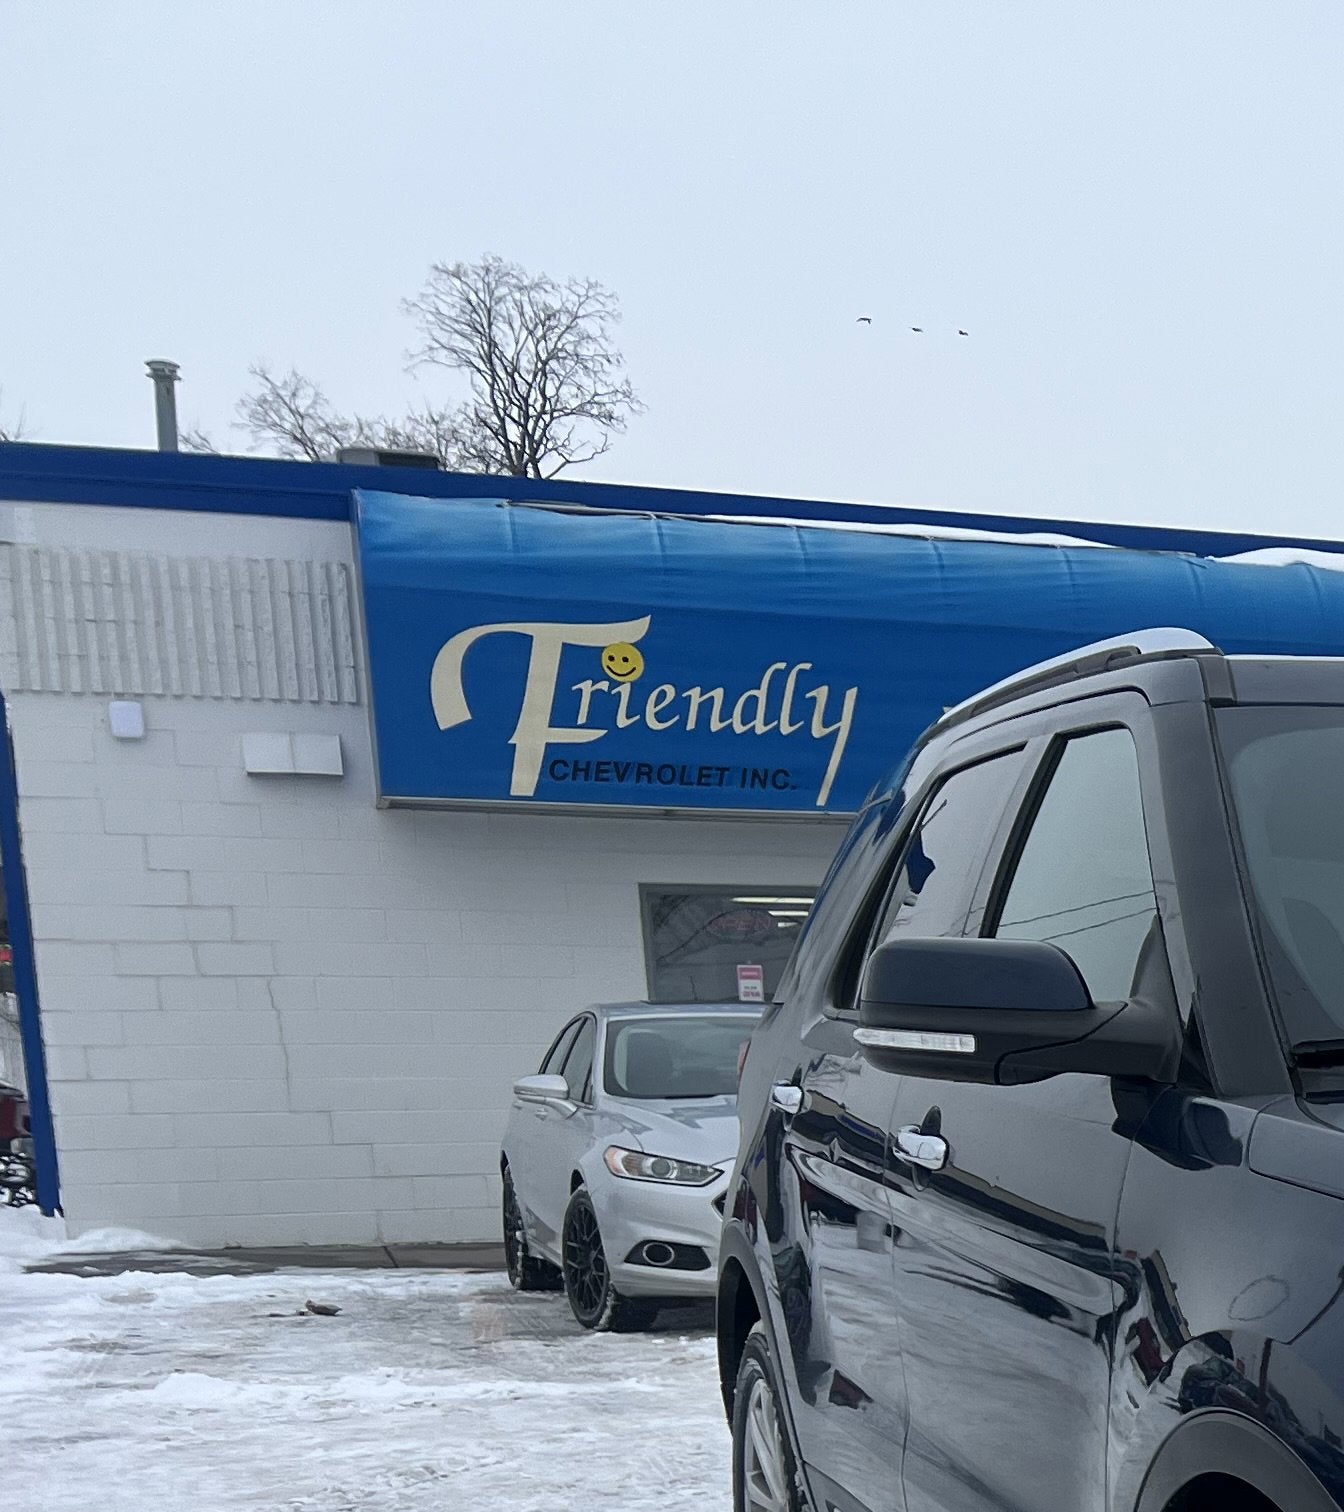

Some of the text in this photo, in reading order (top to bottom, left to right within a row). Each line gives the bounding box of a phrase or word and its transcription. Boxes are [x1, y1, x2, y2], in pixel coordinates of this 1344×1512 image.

[430, 614, 859, 807] Friendly
[549, 758, 798, 791] CHEVROLET INC.
